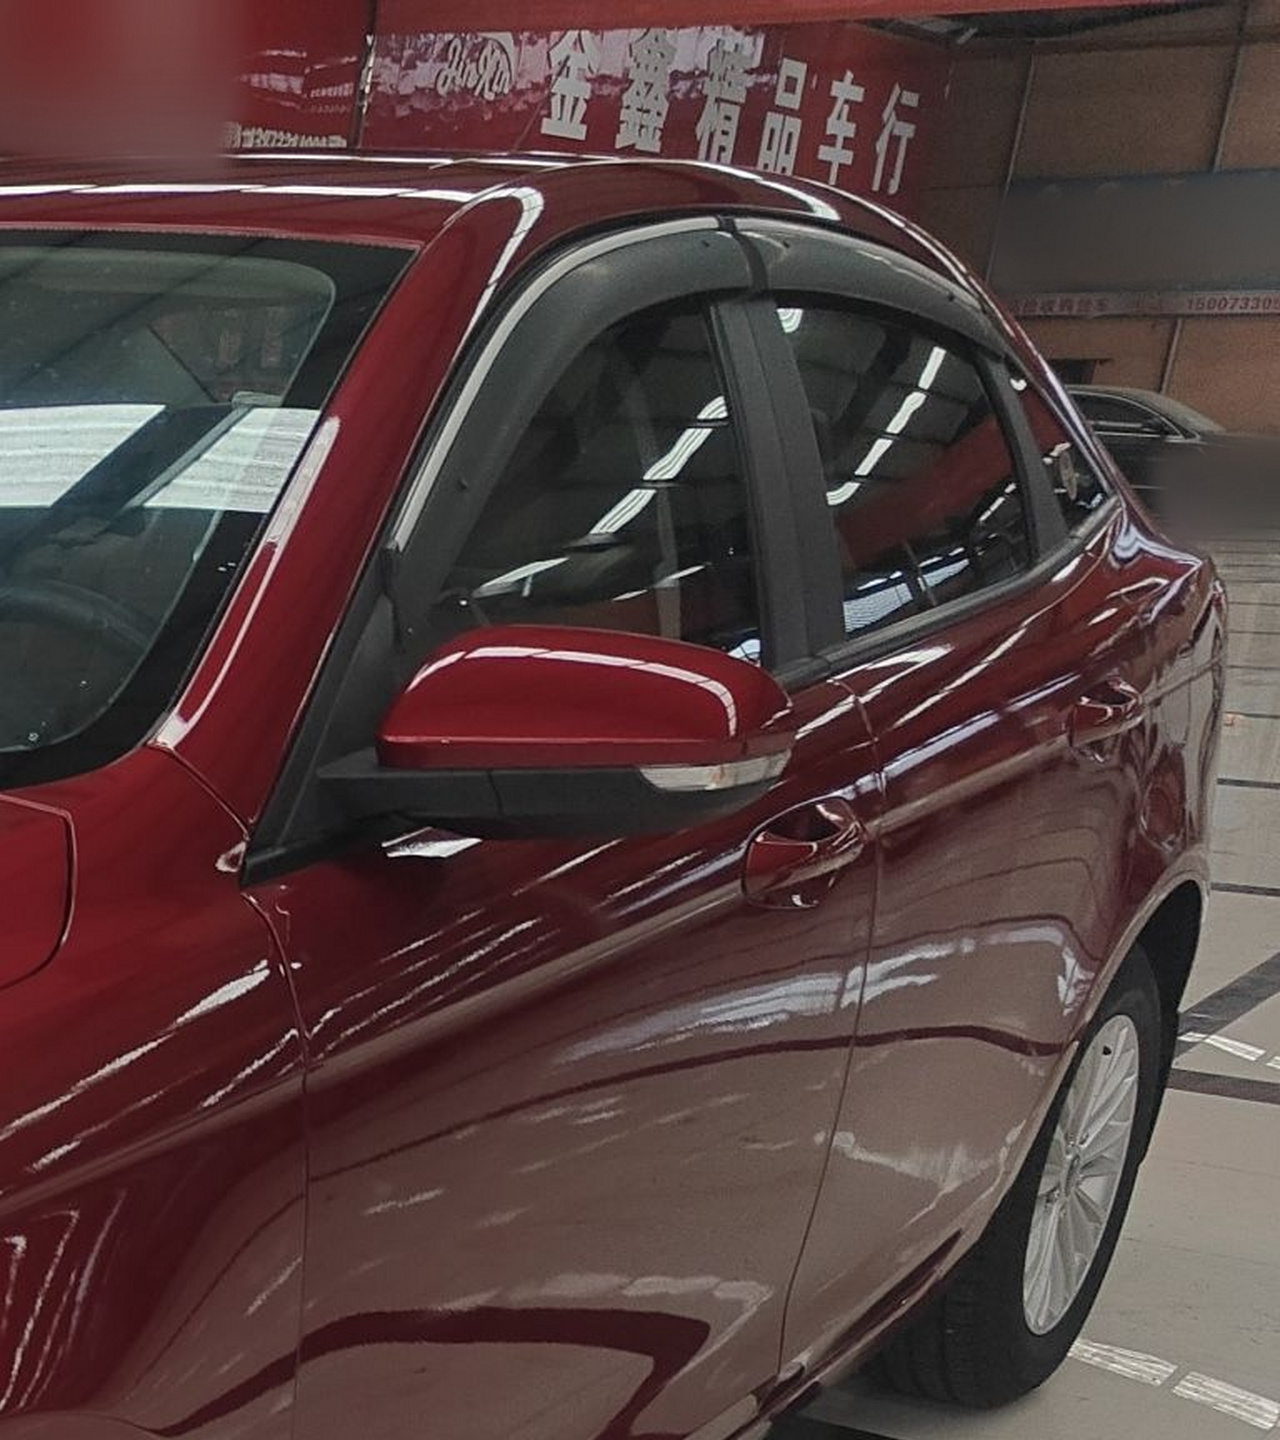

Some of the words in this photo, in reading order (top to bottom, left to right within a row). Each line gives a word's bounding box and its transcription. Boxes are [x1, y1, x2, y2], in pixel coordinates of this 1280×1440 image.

[541, 28, 920, 195] 金鑫精品车行
